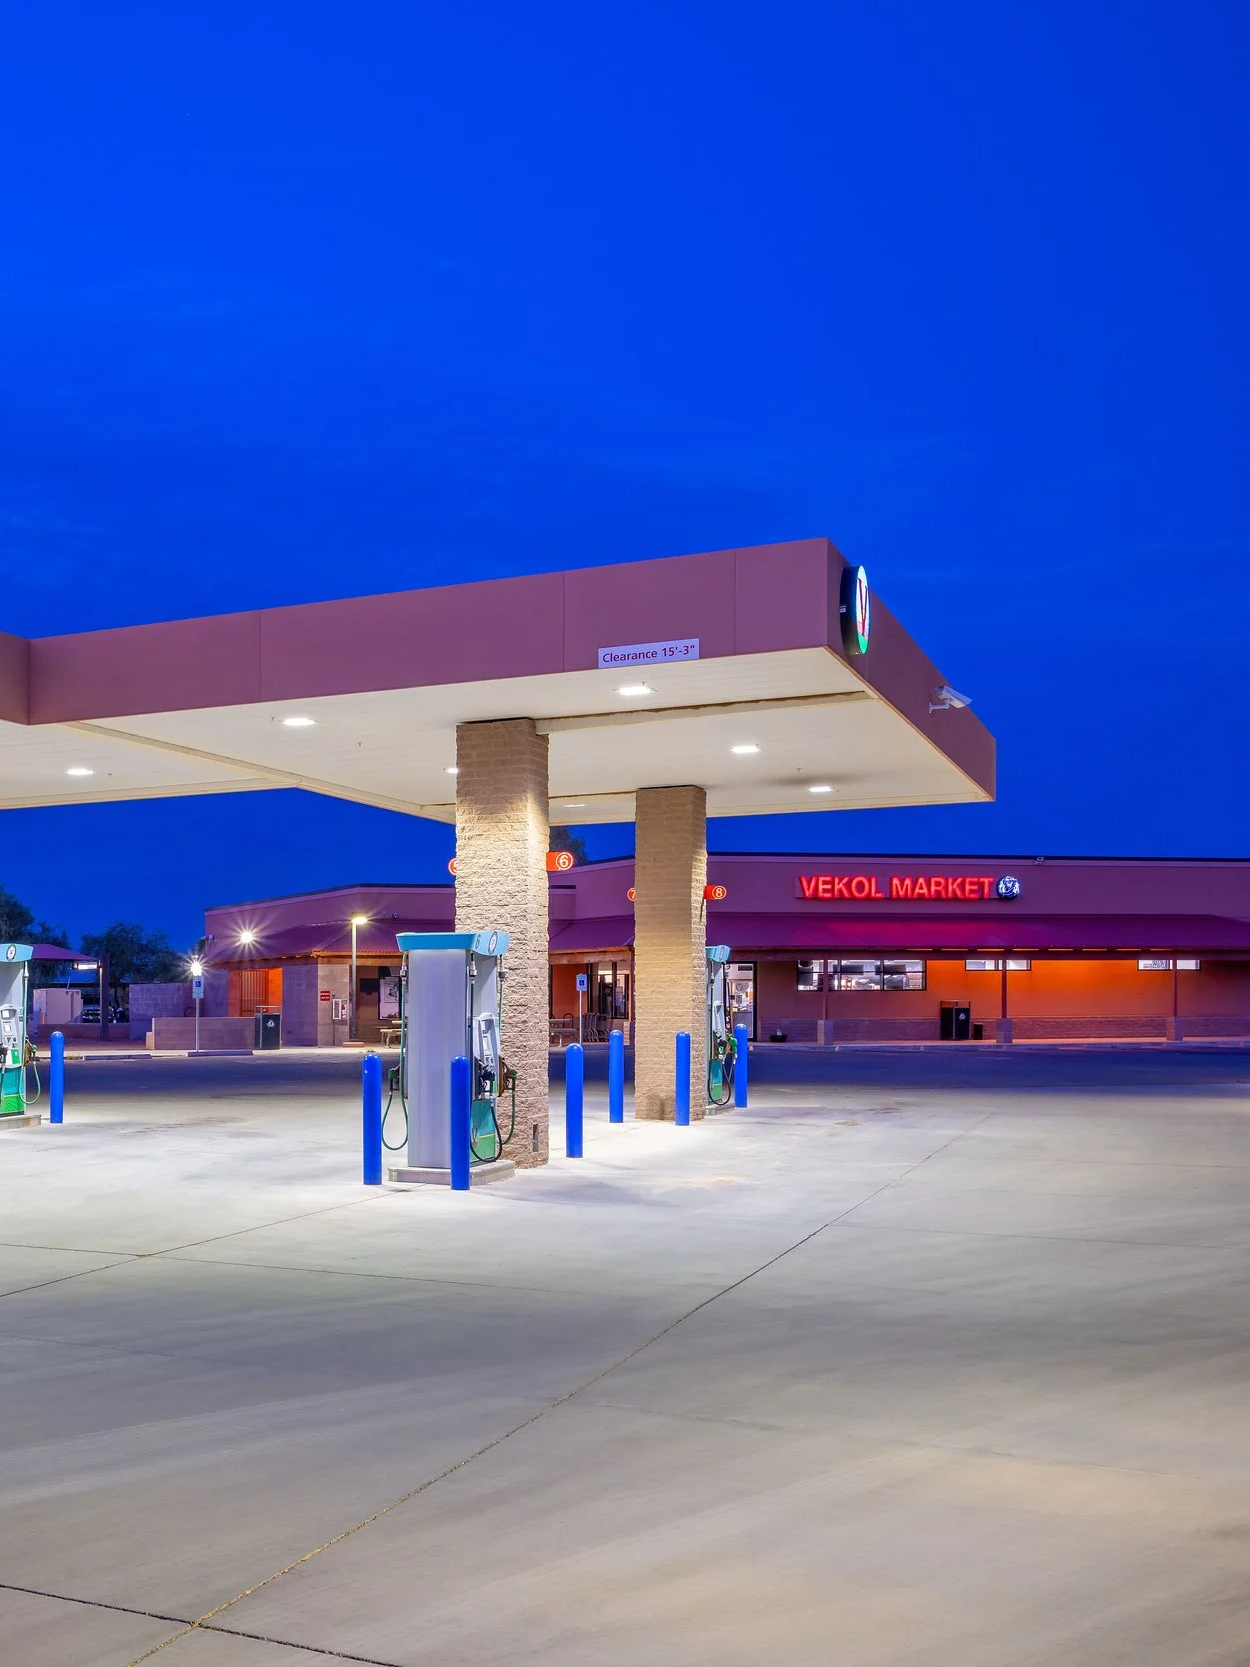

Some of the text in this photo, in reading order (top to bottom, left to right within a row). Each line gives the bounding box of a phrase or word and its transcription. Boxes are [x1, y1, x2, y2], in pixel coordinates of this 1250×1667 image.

[857, 578, 868, 637] V
[602, 650, 658, 663] Clearance
[559, 855, 569, 867] 6
[716, 887, 723, 898] 8
[801, 876, 994, 898] VEKOL MARKET
